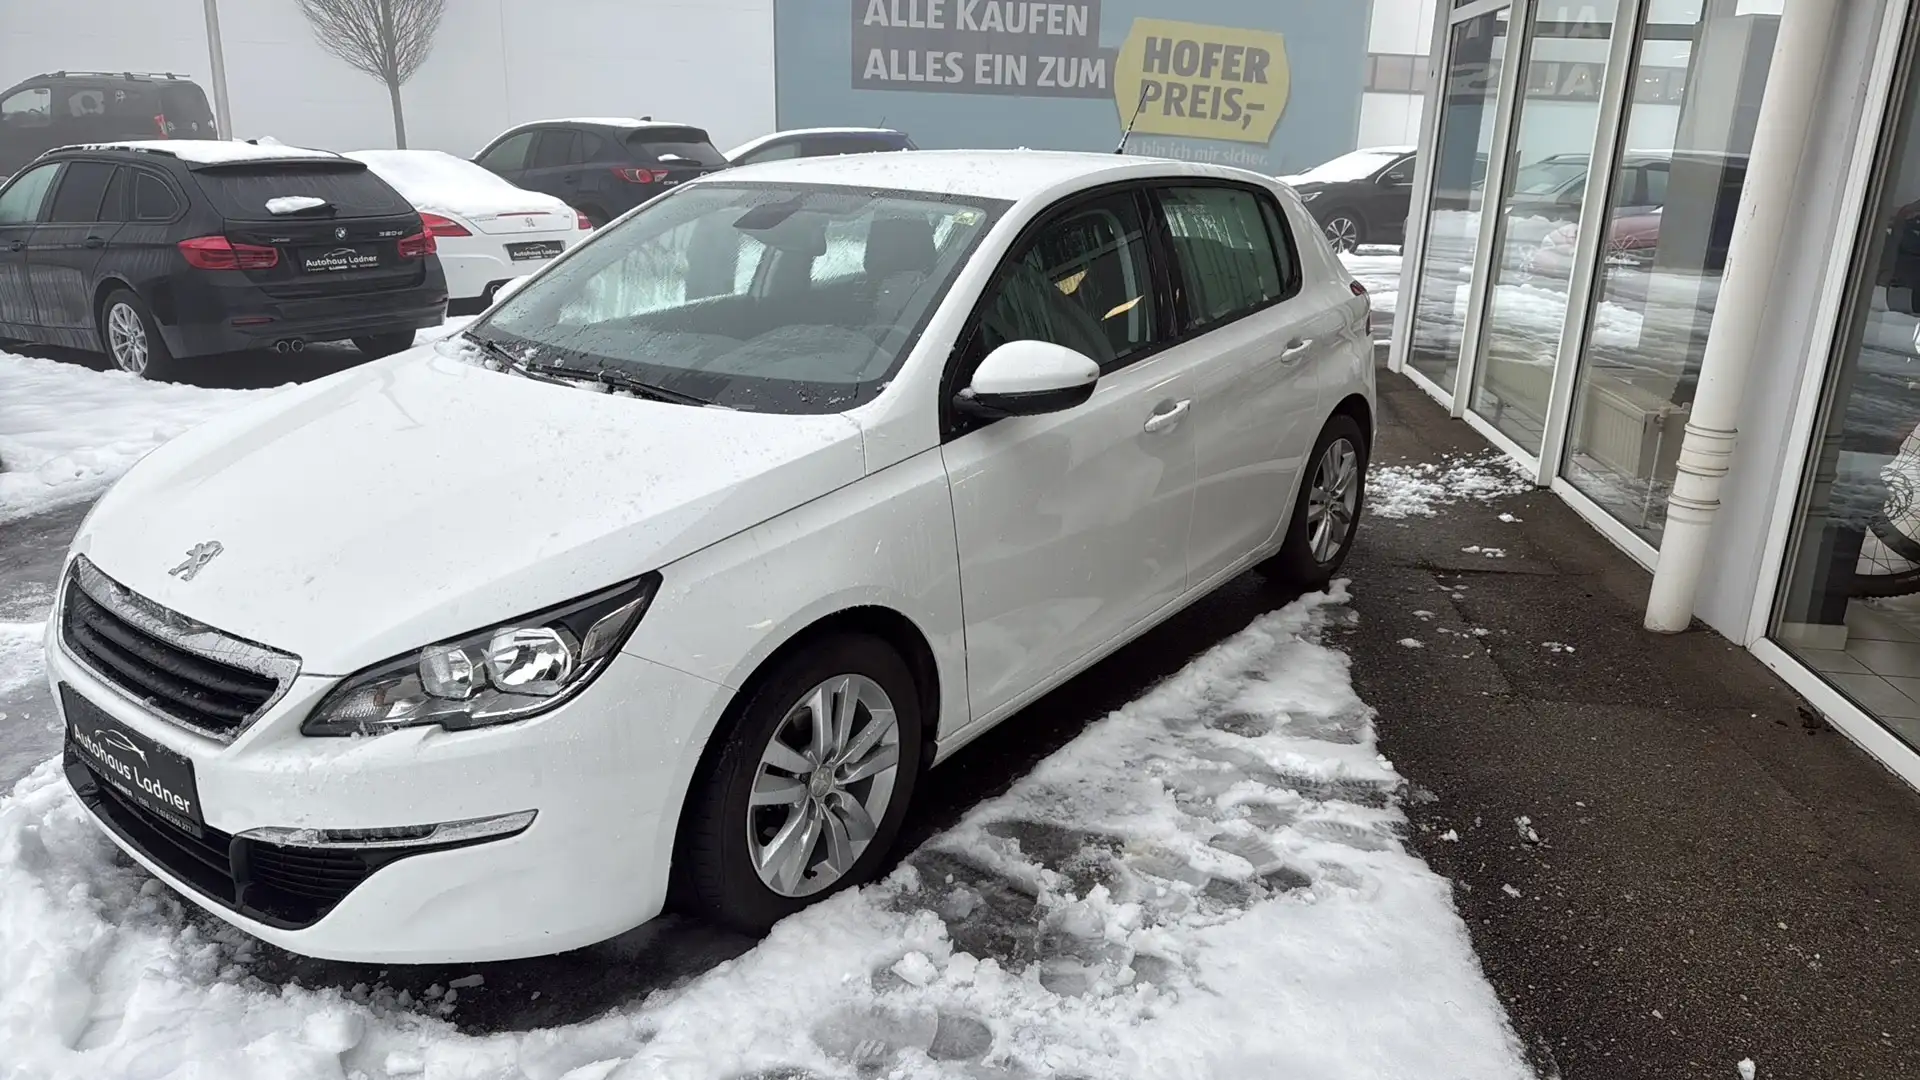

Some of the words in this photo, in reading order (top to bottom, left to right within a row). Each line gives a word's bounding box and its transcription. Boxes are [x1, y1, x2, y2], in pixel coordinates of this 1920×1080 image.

[863, 0, 945, 29] ALLE
[956, 0, 1088, 36] KAUFEN
[863, 48, 964, 84] ALLES
[975, 53, 1027, 86] EIN
[1036, 56, 1106, 89] ZUM
[1142, 36, 1270, 84] HOFER
[1142, 140, 1166, 156] bin
[1170, 142, 1191, 160] ich
[1194, 145, 1220, 161] mir
[1223, 147, 1268, 166] sicher.
[306, 257, 347, 268] Autohaus
[349, 255, 378, 264] Ladner
[74, 724, 132, 780] Autohaus
[133, 766, 191, 814] Ladner
